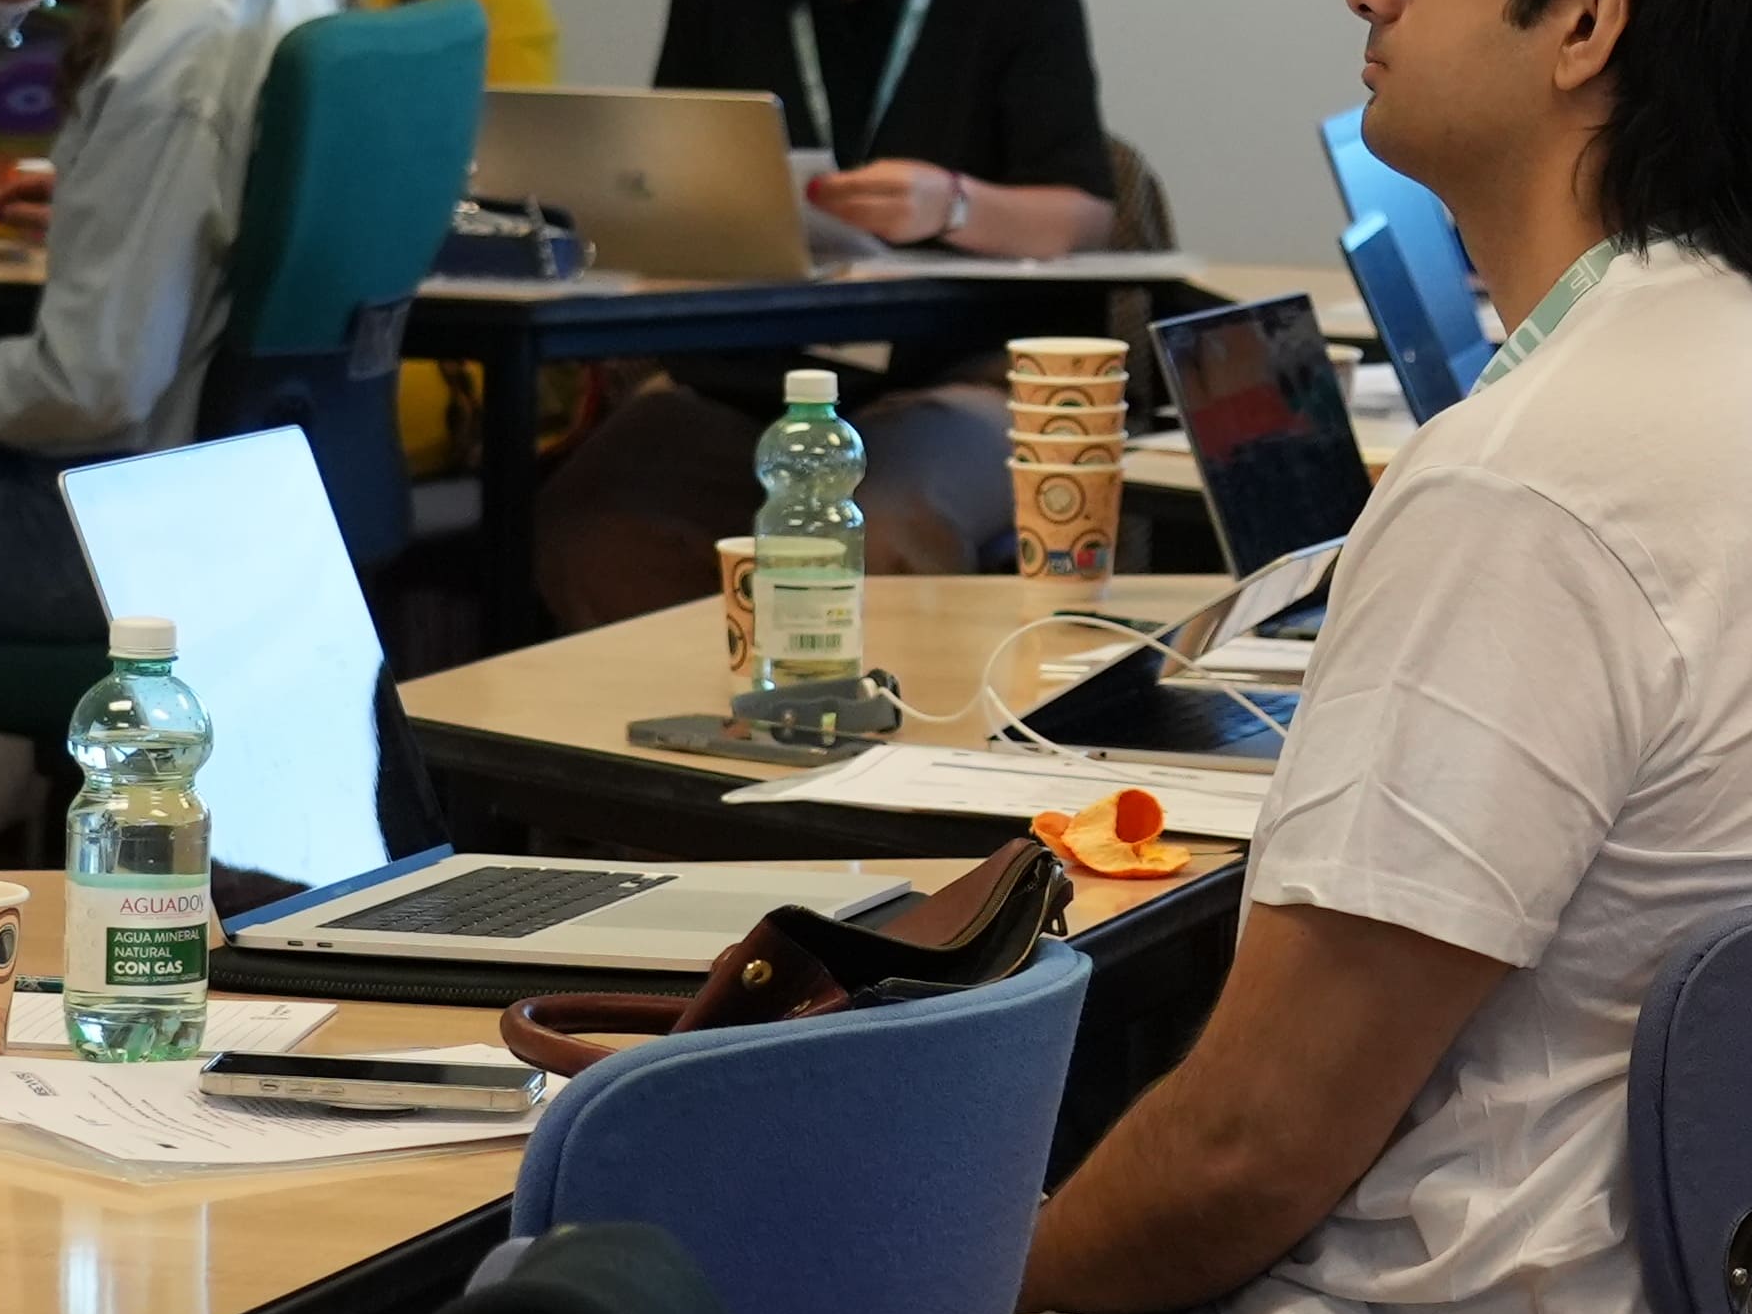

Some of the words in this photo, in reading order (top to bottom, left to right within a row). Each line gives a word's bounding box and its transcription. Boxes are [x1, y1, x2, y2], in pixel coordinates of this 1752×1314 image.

[114, 932, 152, 943] AGUA
[154, 929, 200, 943] MINERAL
[114, 946, 172, 958] NATURAL
[114, 961, 150, 975] CON
[154, 960, 183, 974] GAS
